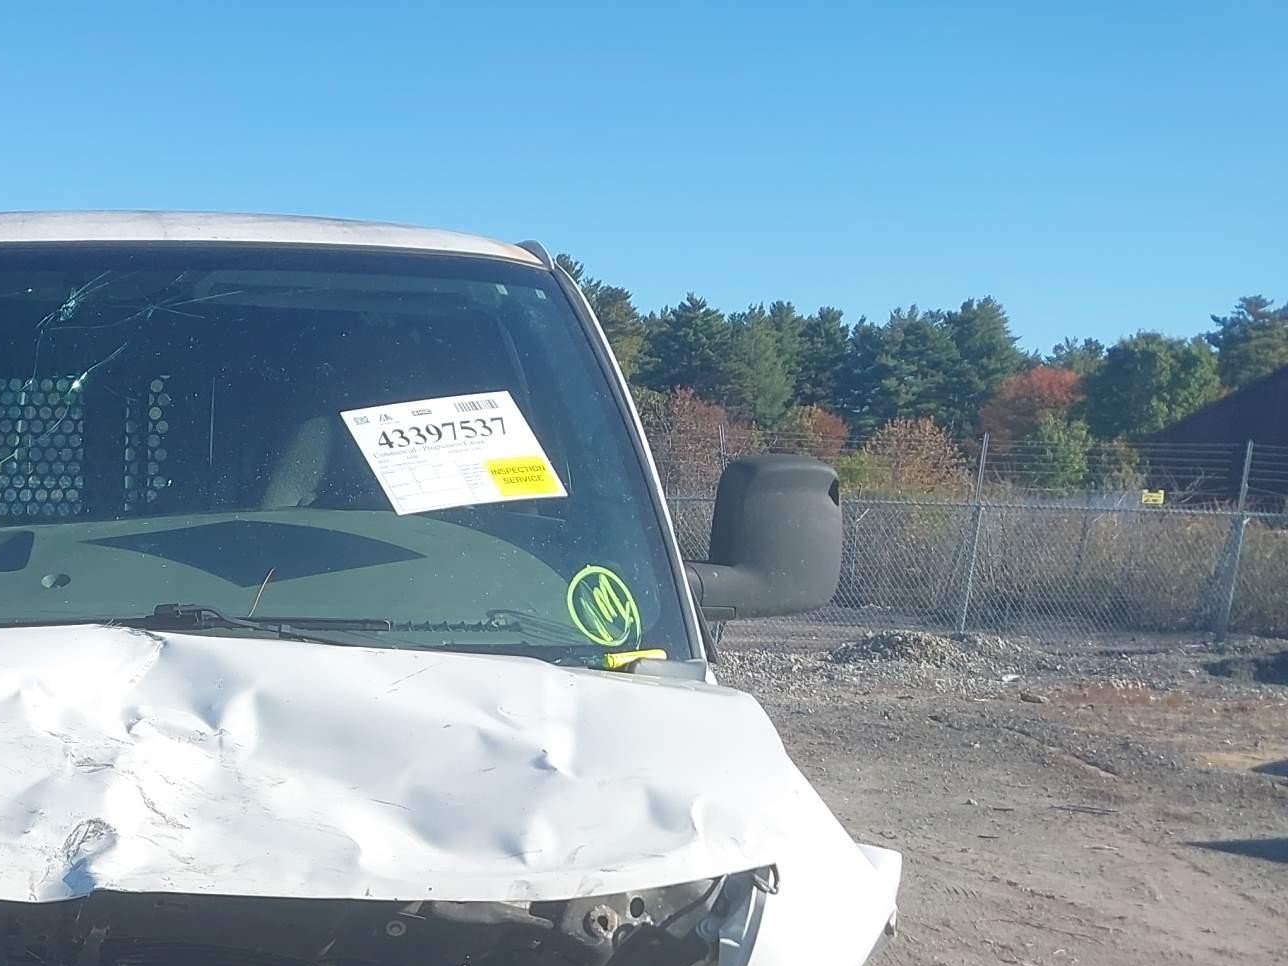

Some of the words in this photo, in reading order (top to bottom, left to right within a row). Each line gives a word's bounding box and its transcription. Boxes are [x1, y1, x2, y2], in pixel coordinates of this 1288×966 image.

[378, 416, 506, 449] 43397537
[491, 464, 546, 476] INSPECTION
[503, 474, 545, 485] SERVICE
